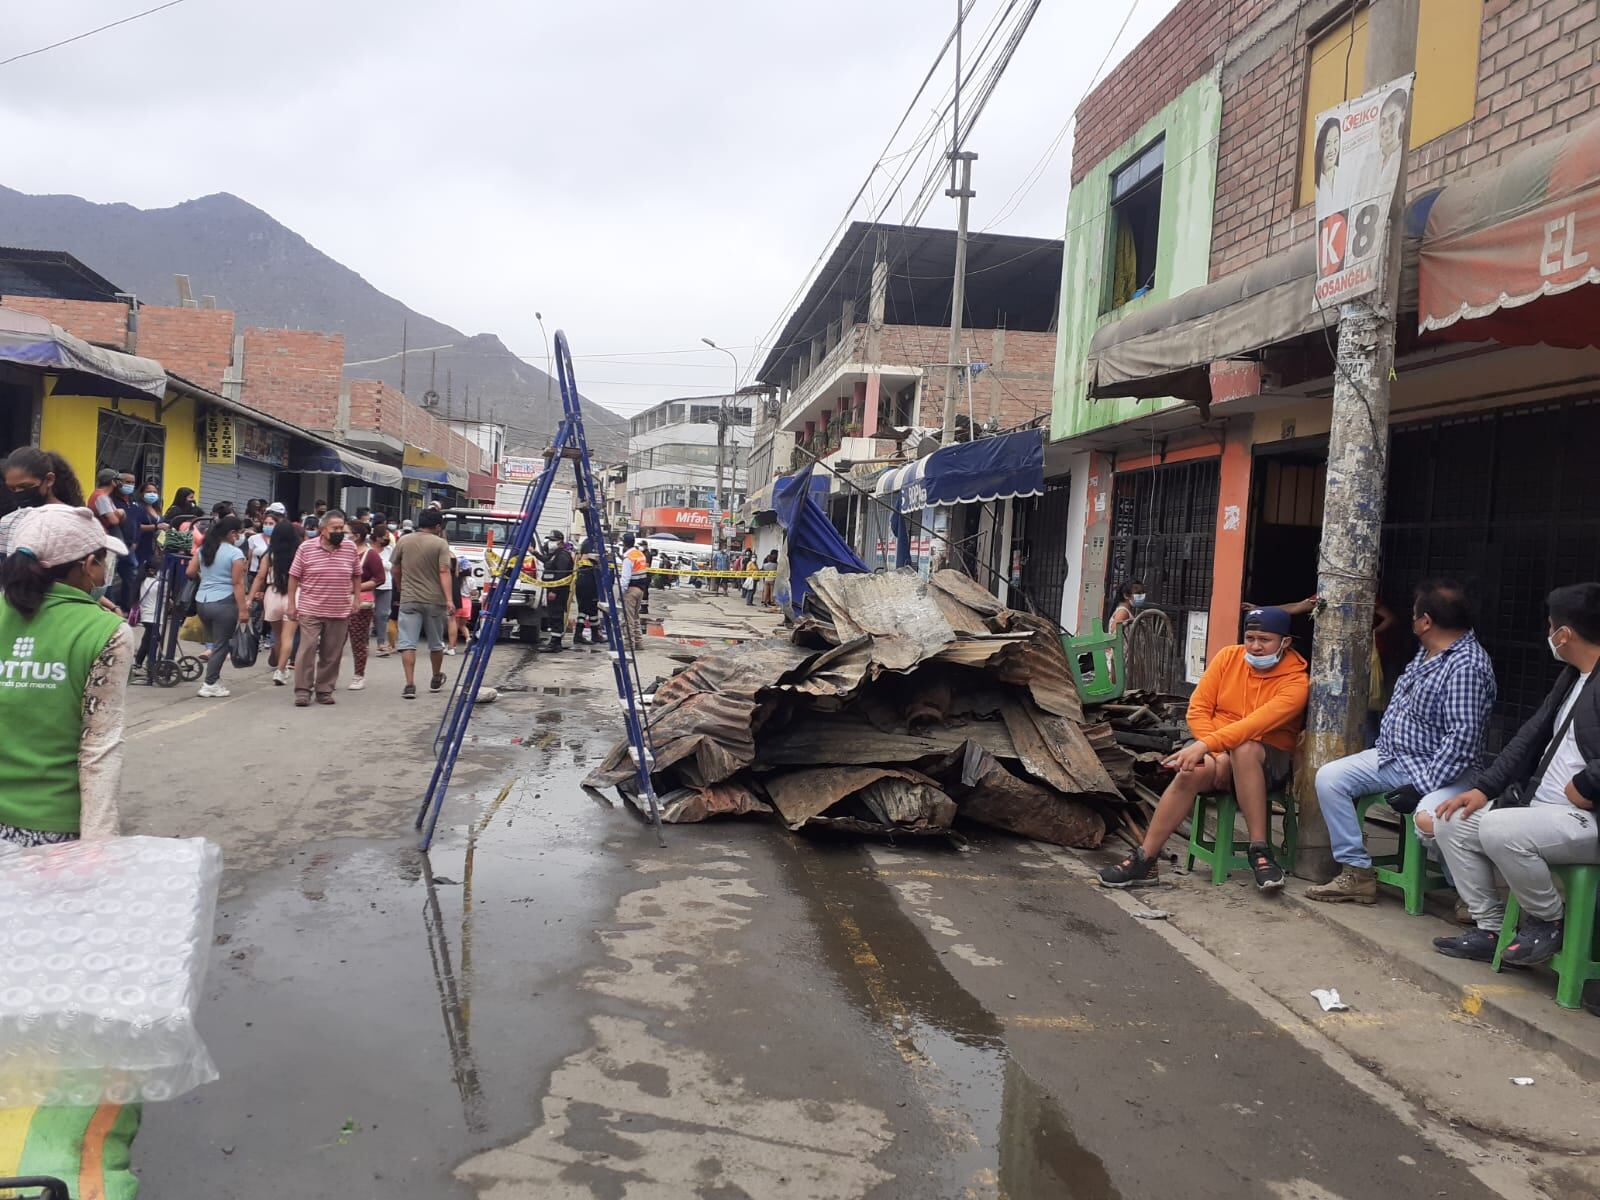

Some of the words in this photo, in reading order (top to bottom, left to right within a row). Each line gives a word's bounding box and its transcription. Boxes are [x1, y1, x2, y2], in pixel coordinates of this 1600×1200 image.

[1343, 106, 1379, 132] KEIKO
[1352, 203, 1380, 258] 8
[1540, 211, 1588, 276] EL
[1316, 264, 1373, 299] ROSANGELA
[0, 661, 66, 681] TTUS
